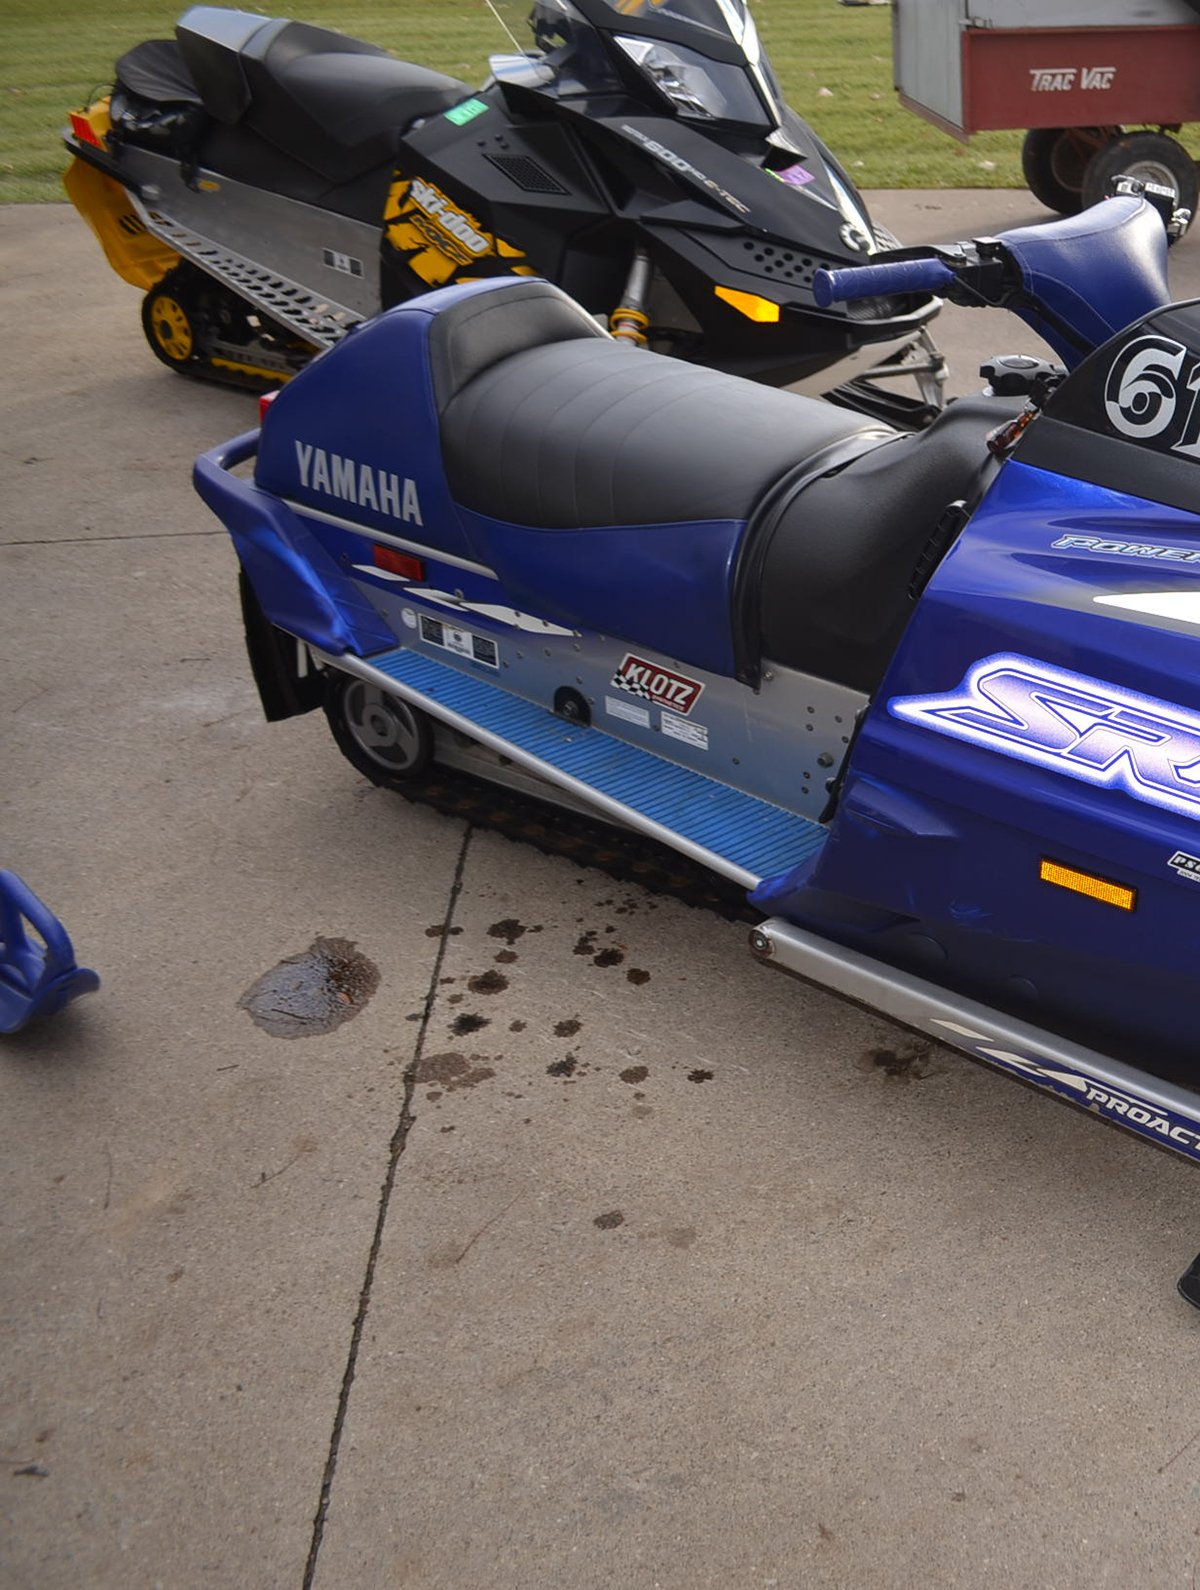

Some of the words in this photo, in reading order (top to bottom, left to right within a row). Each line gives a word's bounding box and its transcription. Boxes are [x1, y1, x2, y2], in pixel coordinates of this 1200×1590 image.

[1029, 68, 1077, 91] TRAC
[1081, 66, 1116, 90] VAC
[409, 179, 490, 253] ski-doo
[295, 439, 424, 527] YAMAHA
[625, 663, 695, 705] KLOTZ
